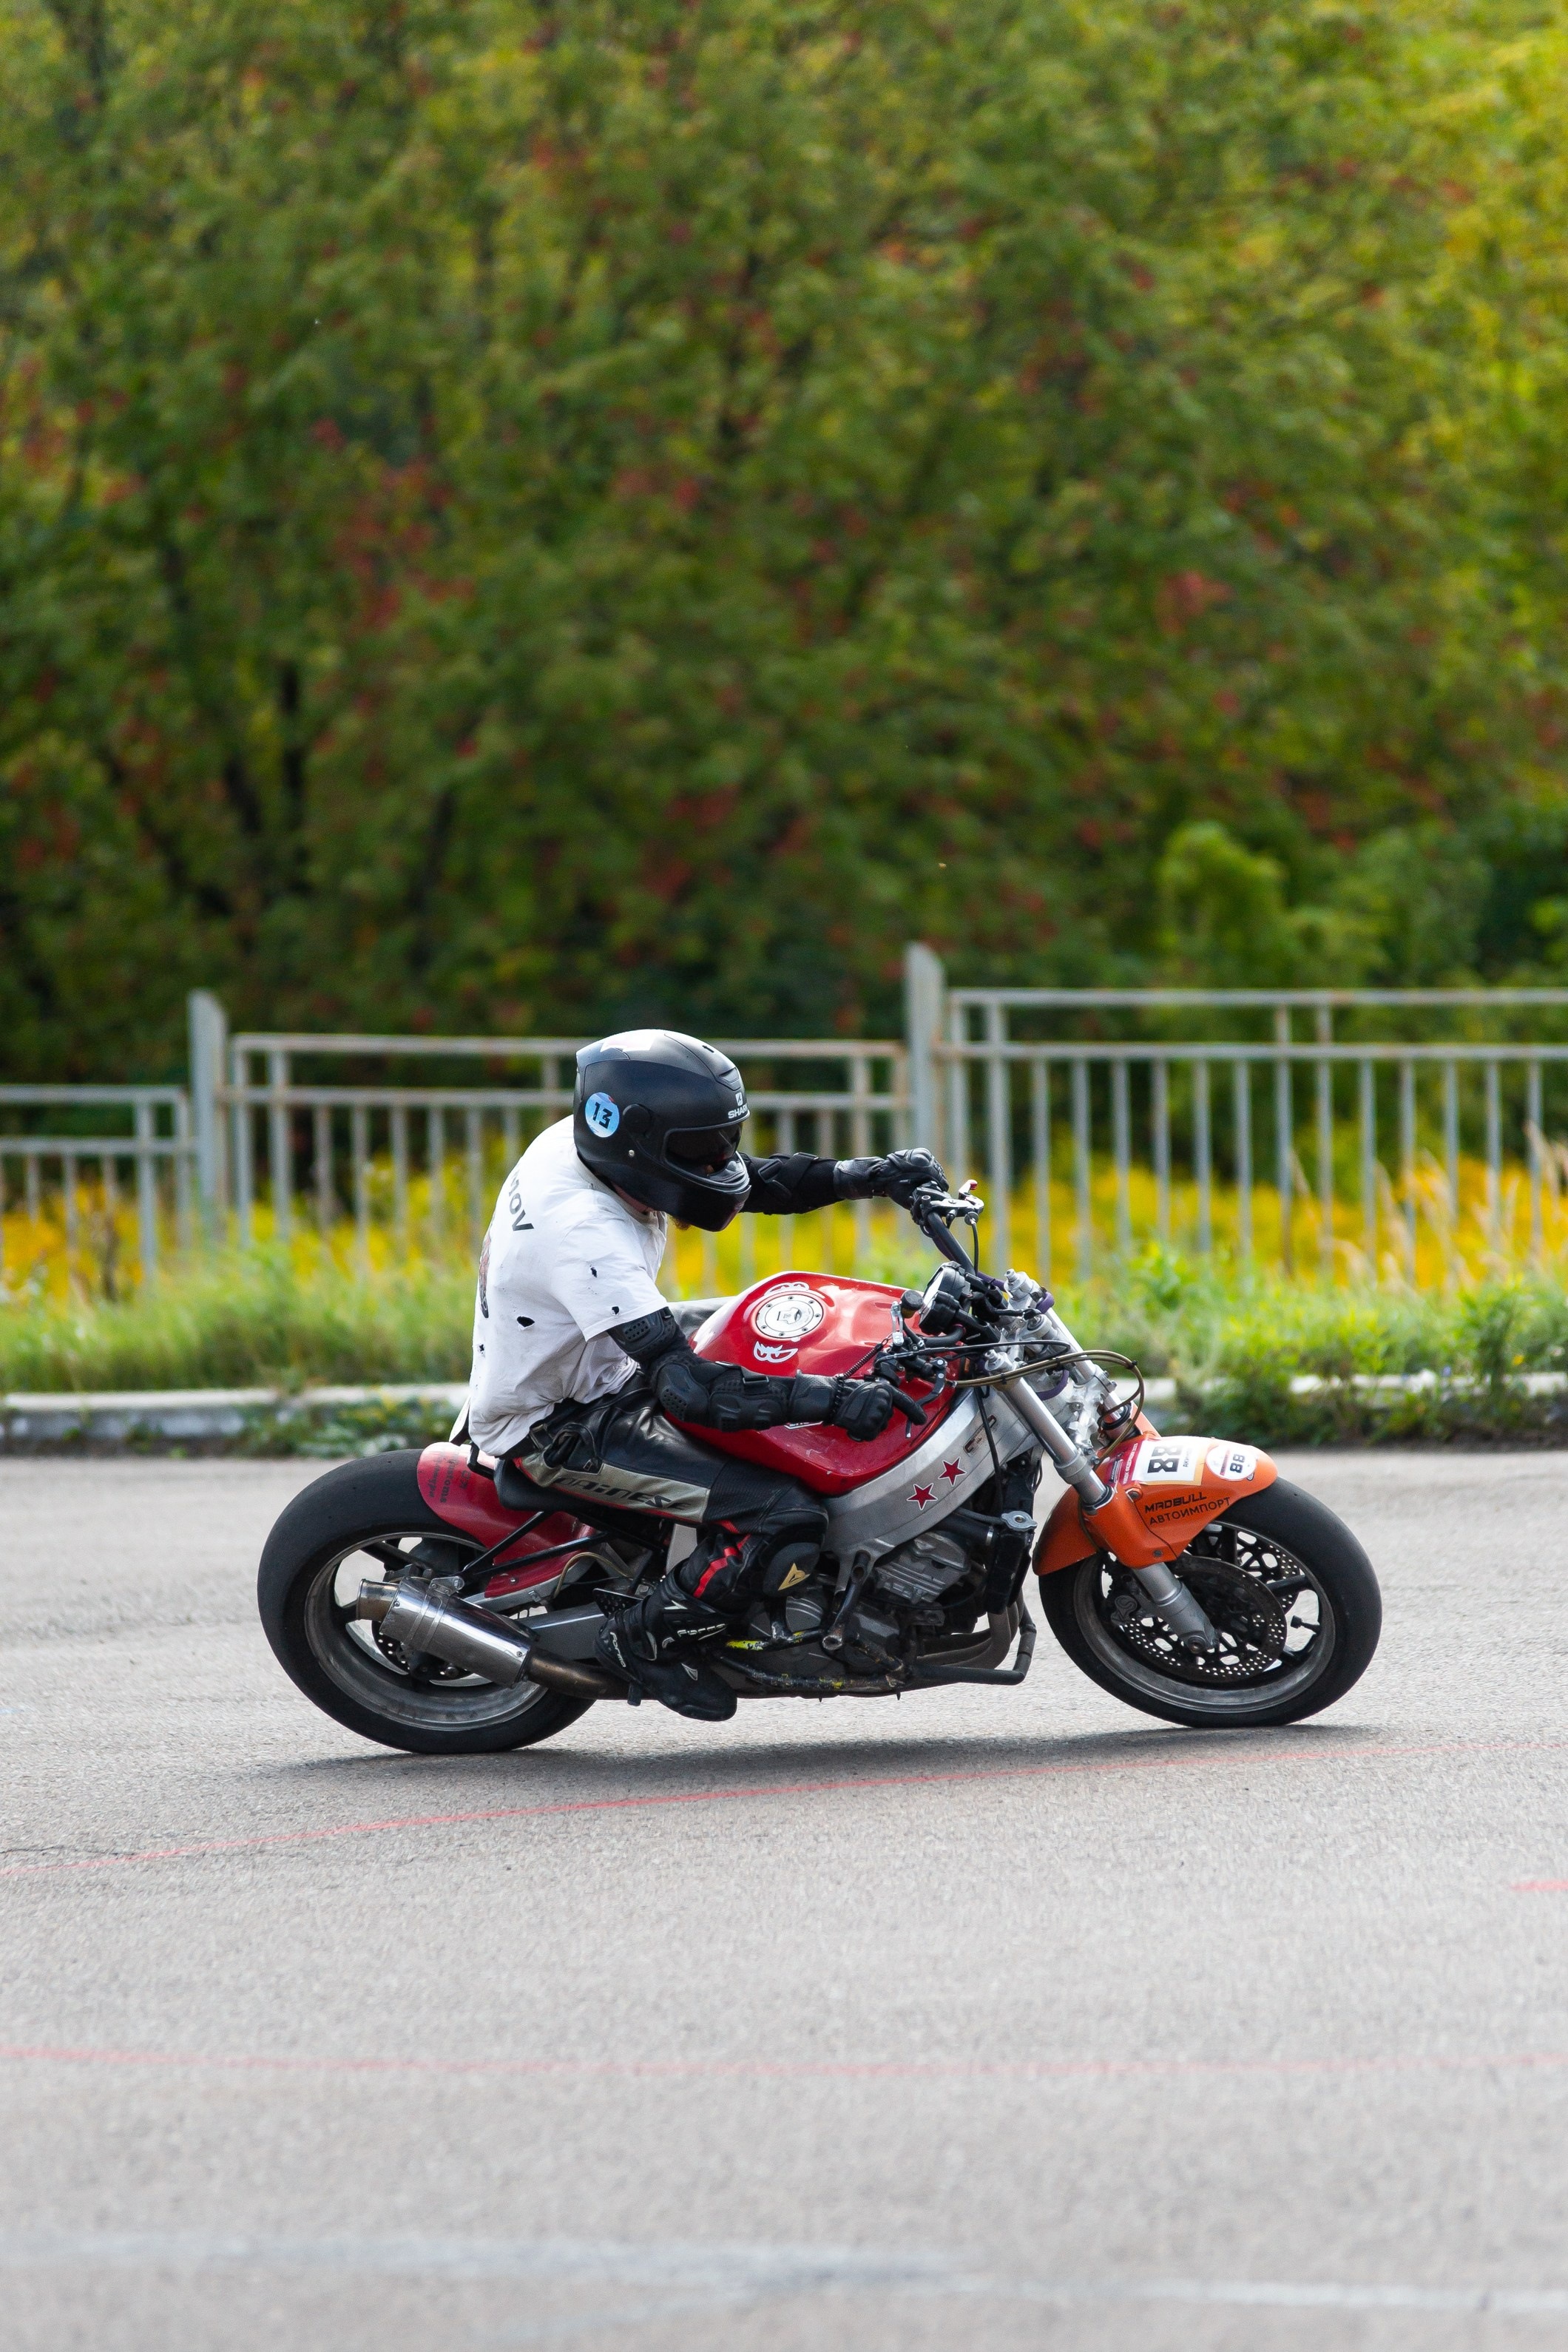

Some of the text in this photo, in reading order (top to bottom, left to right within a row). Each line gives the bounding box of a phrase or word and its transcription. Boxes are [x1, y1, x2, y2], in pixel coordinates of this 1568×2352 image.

[592, 1101, 613, 1129] 13
[1147, 1445, 1183, 1473] 88
[1229, 1453, 1246, 1473] 88
[1144, 1491, 1208, 1514] MADBULL
[1149, 1496, 1231, 1525] АВТОИМПОРТ
